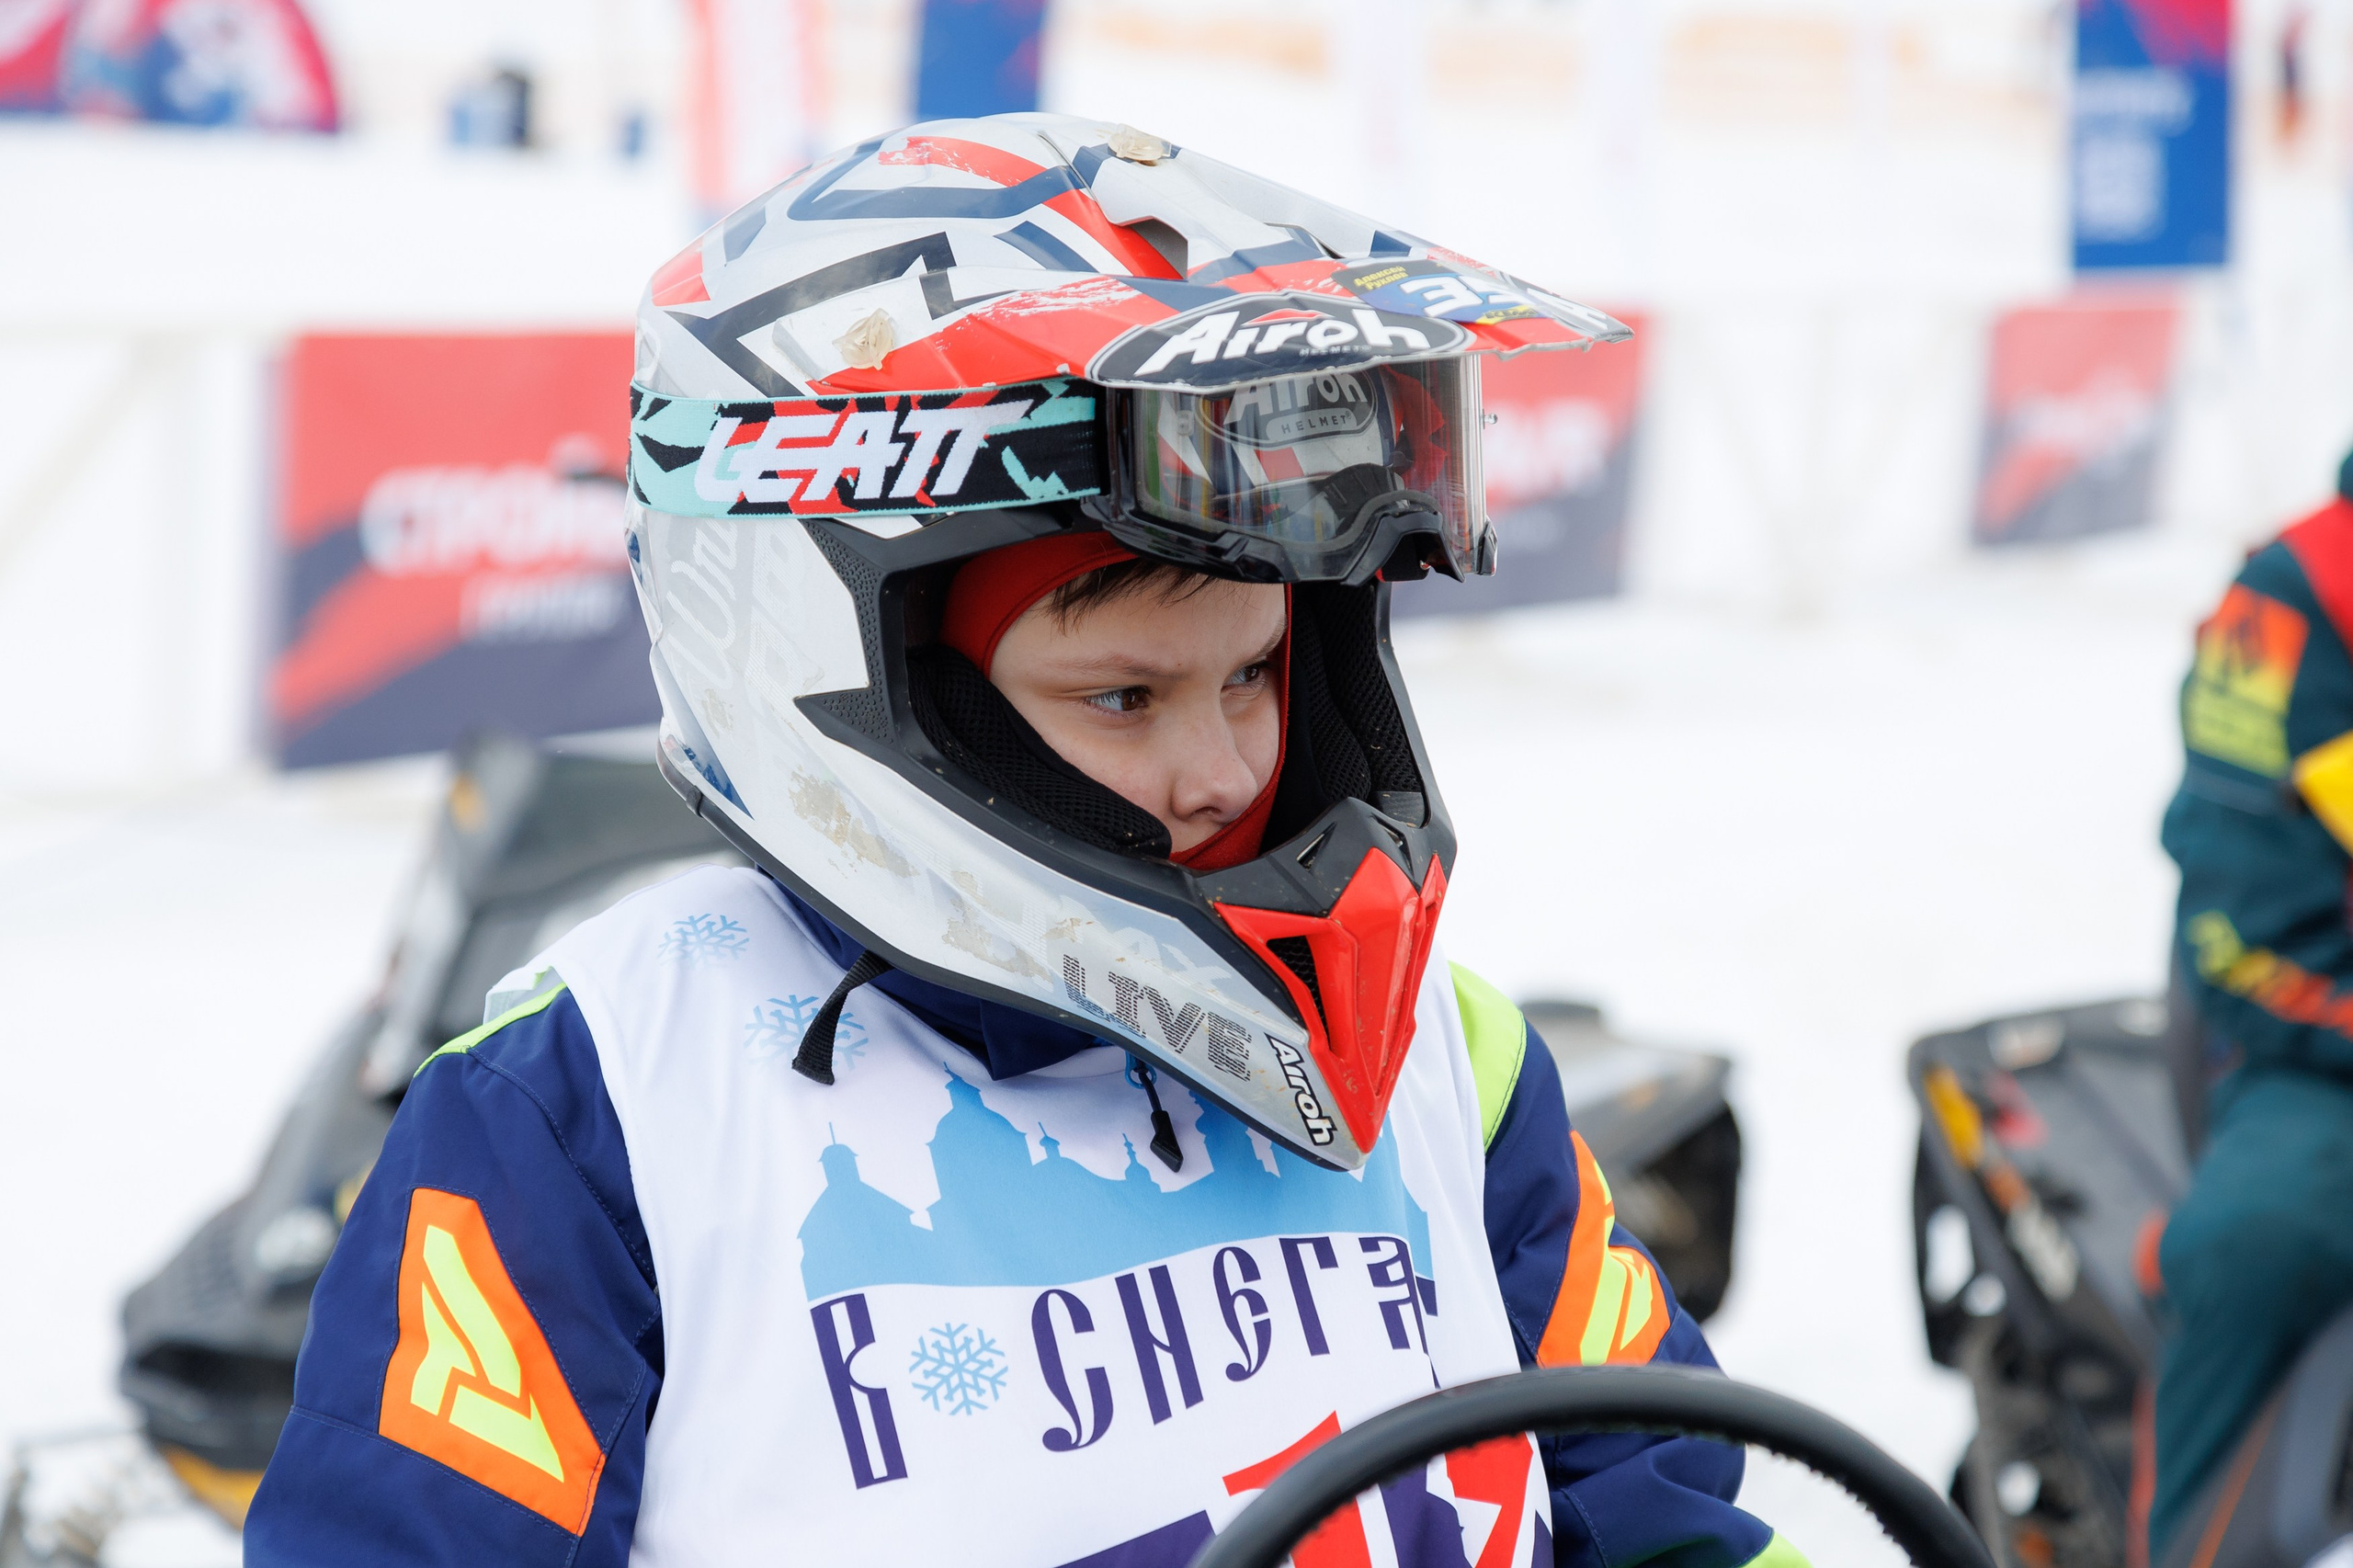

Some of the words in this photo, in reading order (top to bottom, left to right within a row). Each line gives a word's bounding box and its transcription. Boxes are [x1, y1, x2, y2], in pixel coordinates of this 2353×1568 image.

[1133, 309, 1431, 377] Airoh
[694, 399, 1034, 503] LEATT
[1281, 415, 1347, 435] HELMET
[1265, 1031, 1338, 1147] Airoh
